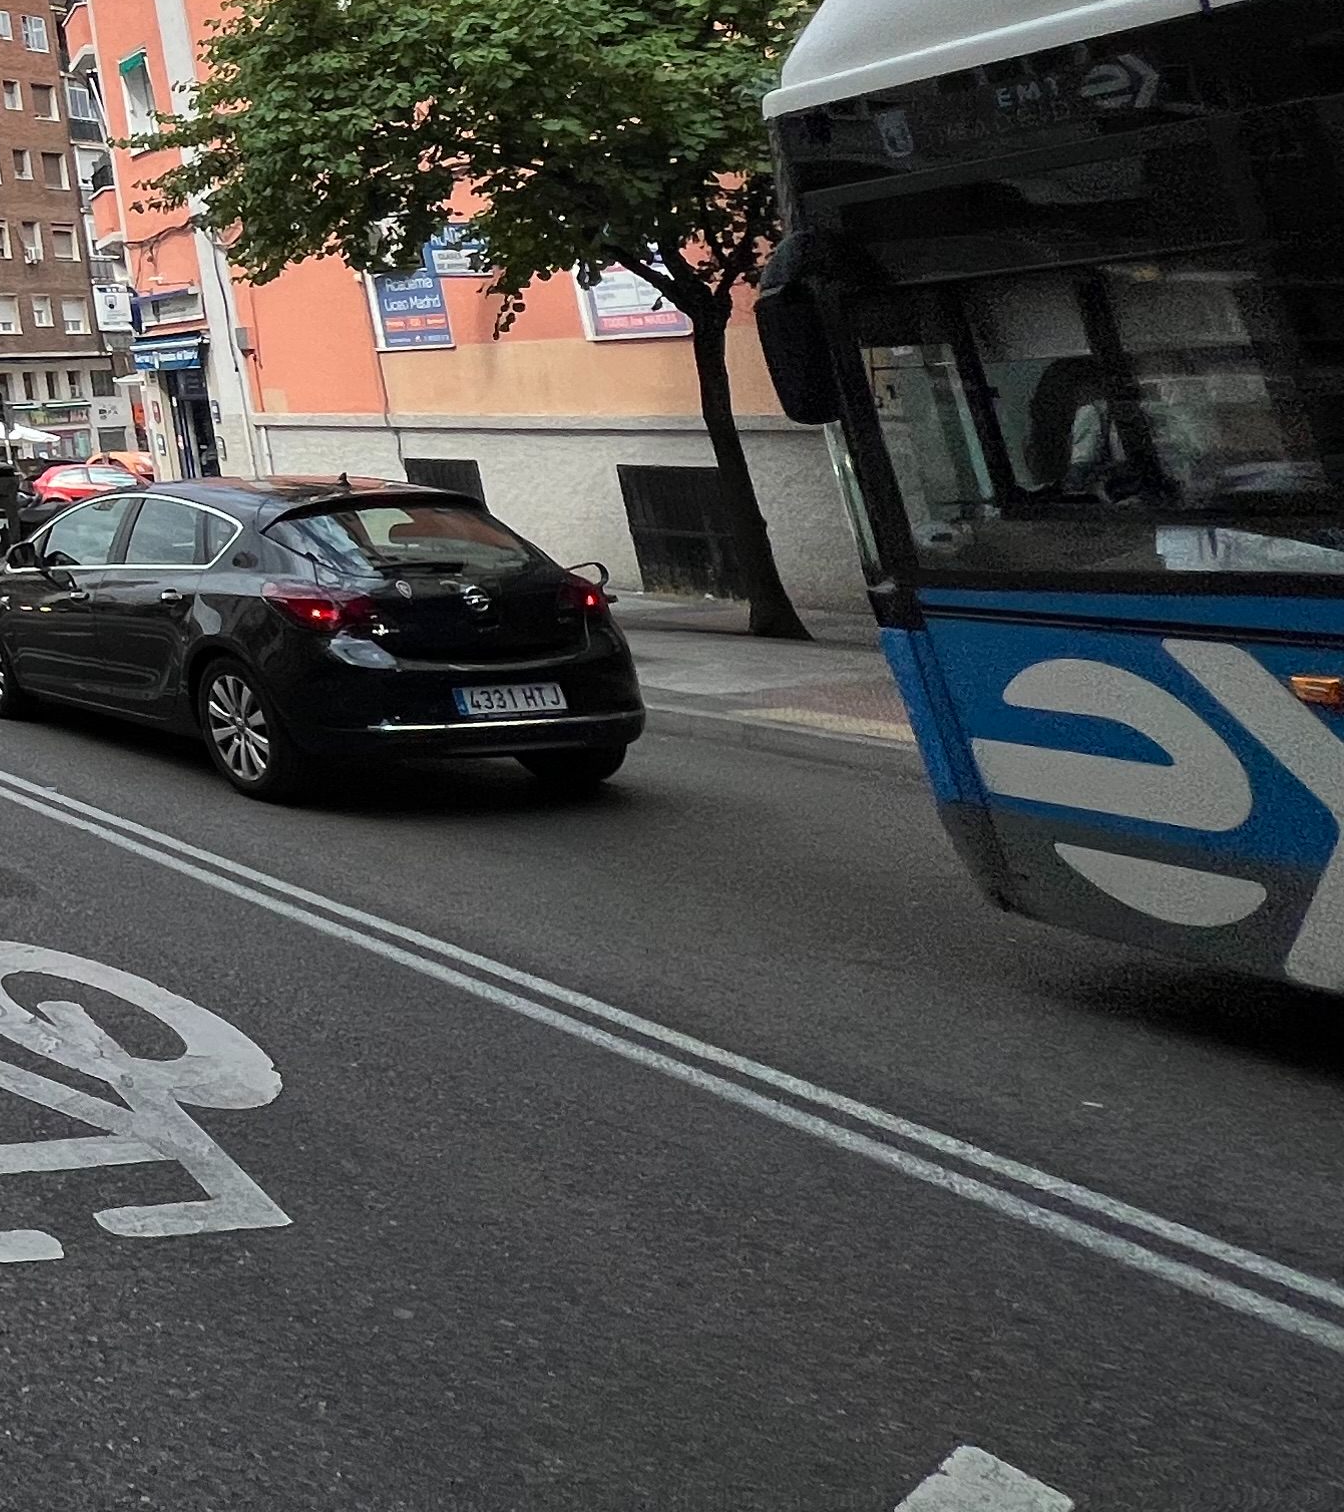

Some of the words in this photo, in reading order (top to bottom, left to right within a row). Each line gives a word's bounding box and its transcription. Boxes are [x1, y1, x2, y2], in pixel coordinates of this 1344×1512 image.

[410, 293, 441, 309] Madrid
[469, 690, 518, 710] 4331
[522, 685, 561, 707] HTJ
